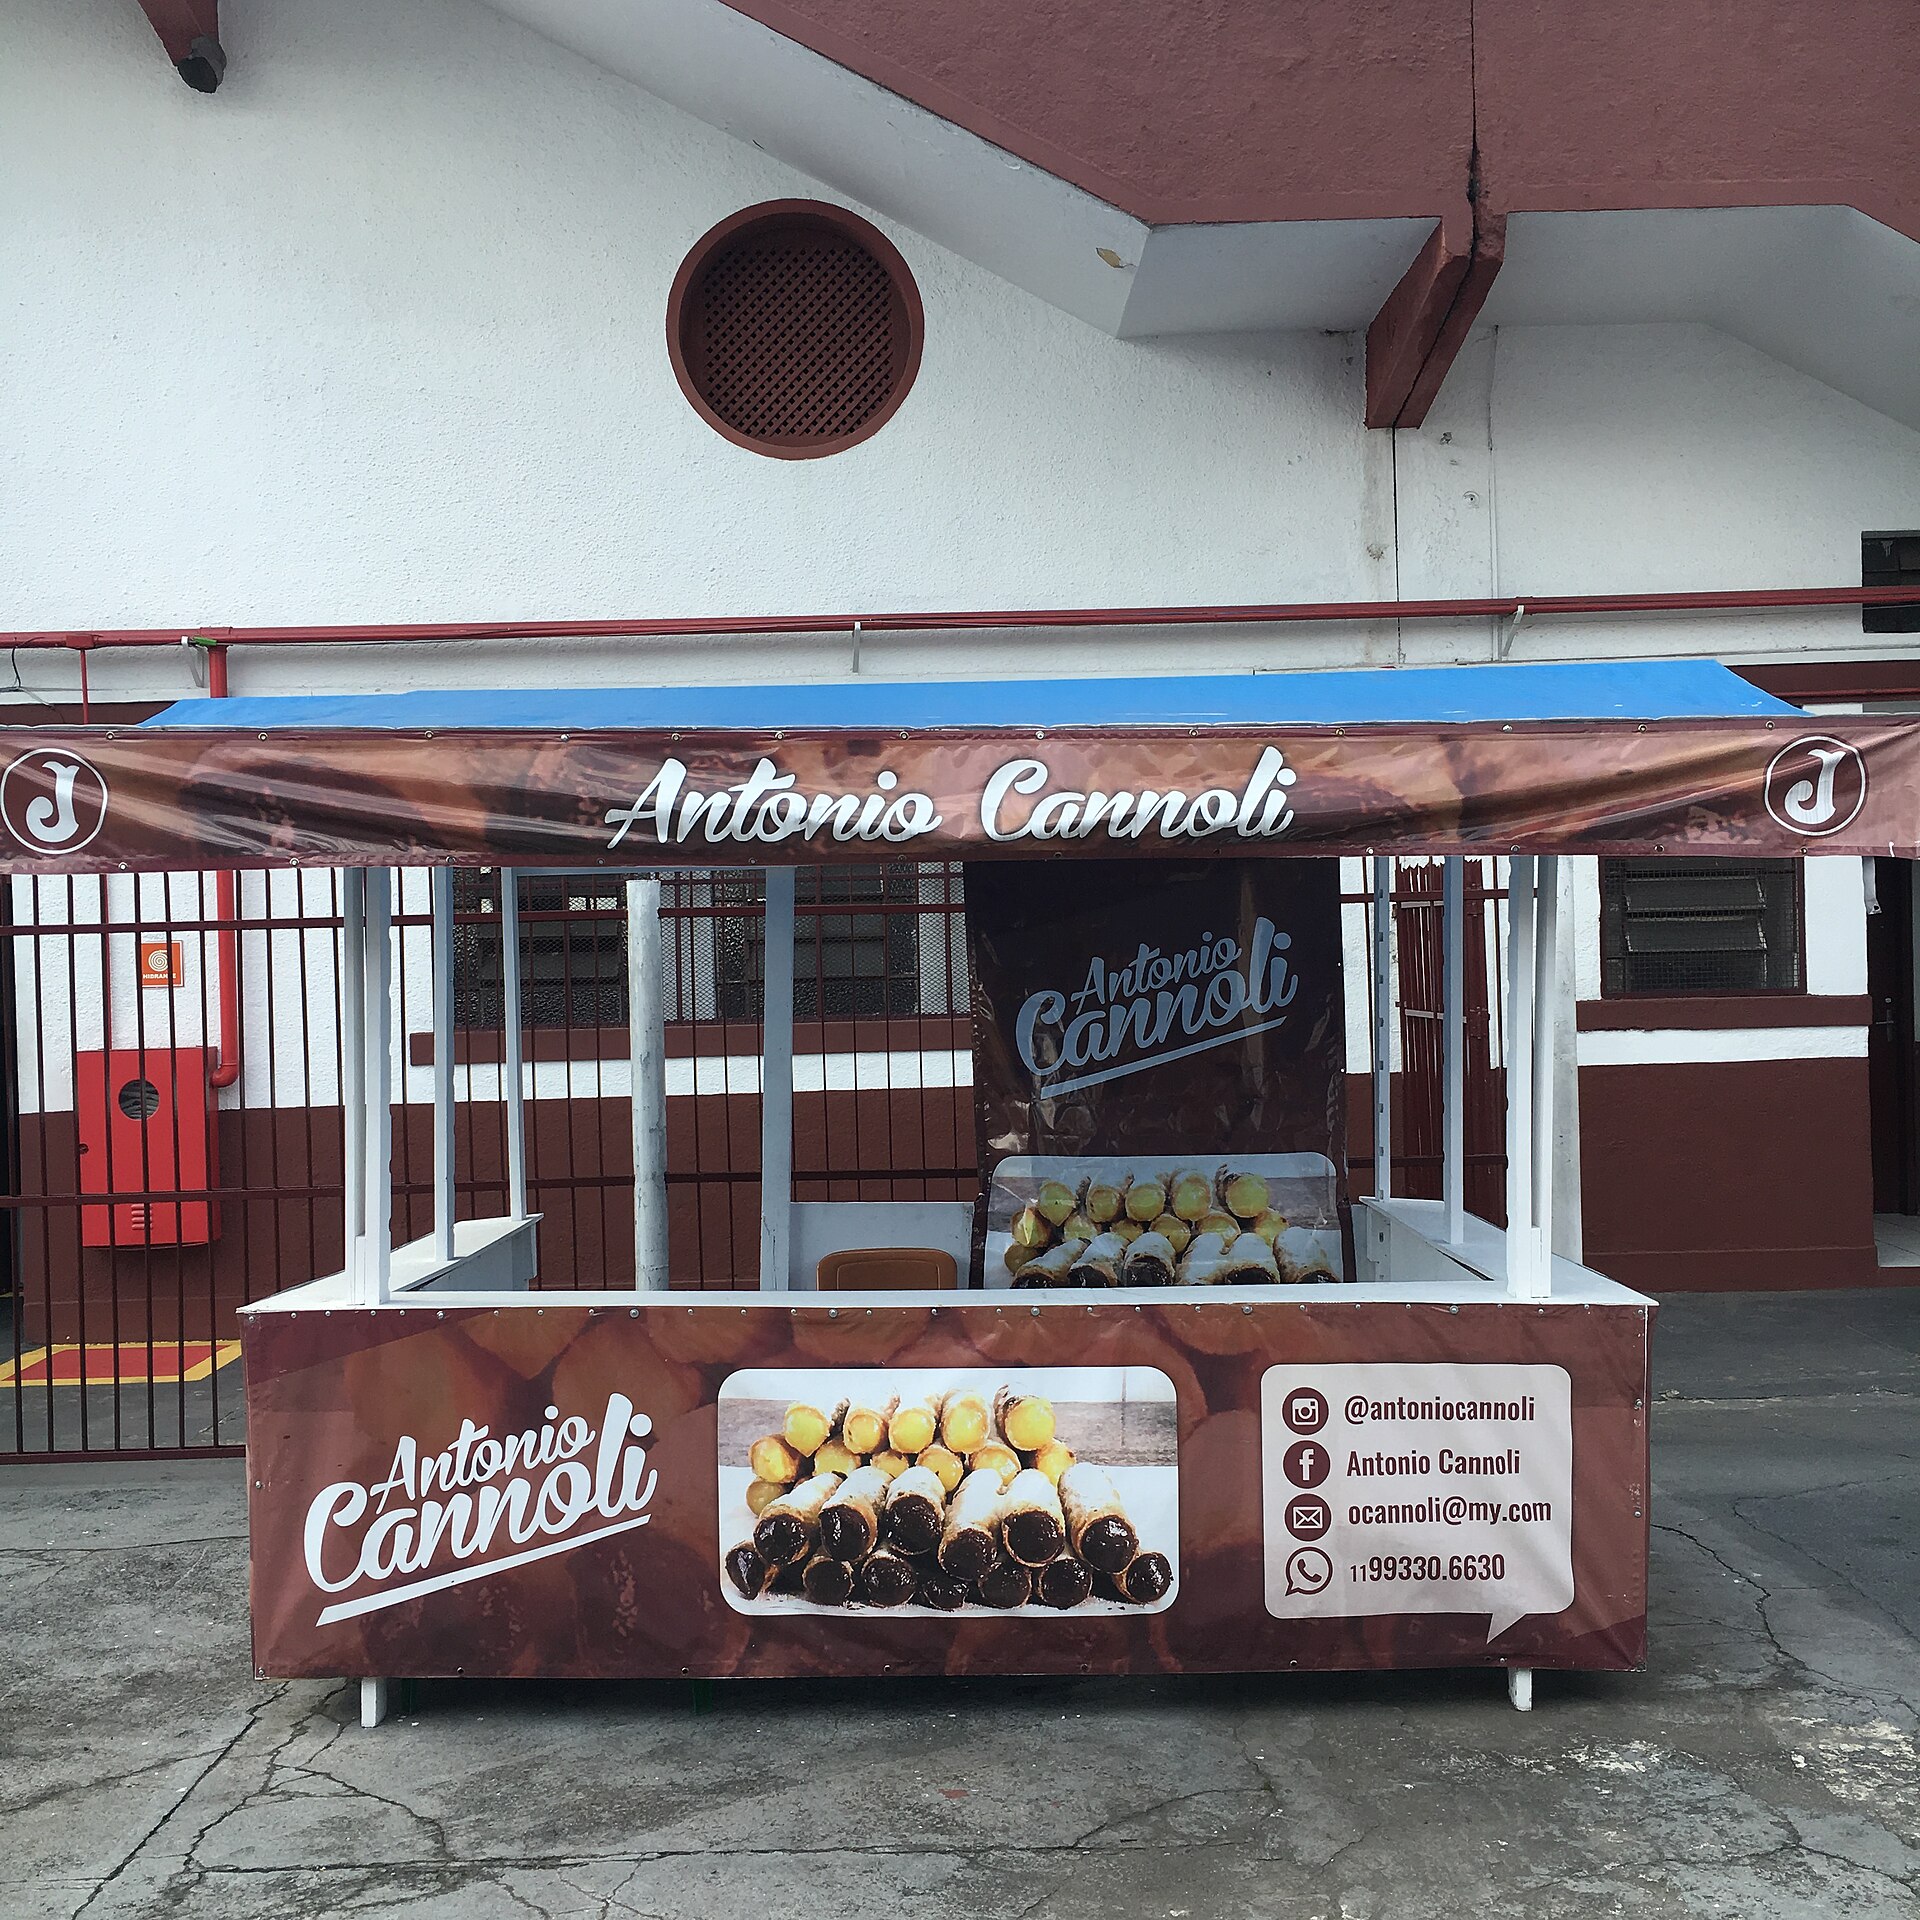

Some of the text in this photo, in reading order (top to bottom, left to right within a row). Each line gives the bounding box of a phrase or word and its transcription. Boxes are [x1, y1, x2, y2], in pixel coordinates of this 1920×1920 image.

[605, 746, 1297, 848] Antonio Cannoli
[1016, 917, 1298, 1076] Cannoli
[1072, 932, 1242, 1015] Antonio
[1344, 1396, 1535, 1424] @antoniocannoli
[304, 1393, 658, 1593] Cannoli
[370, 1405, 596, 1514] Antonio
[1347, 1449, 1520, 1477] Antonio Cannoli
[1348, 1496, 1552, 1525] ocannoli@my.com
